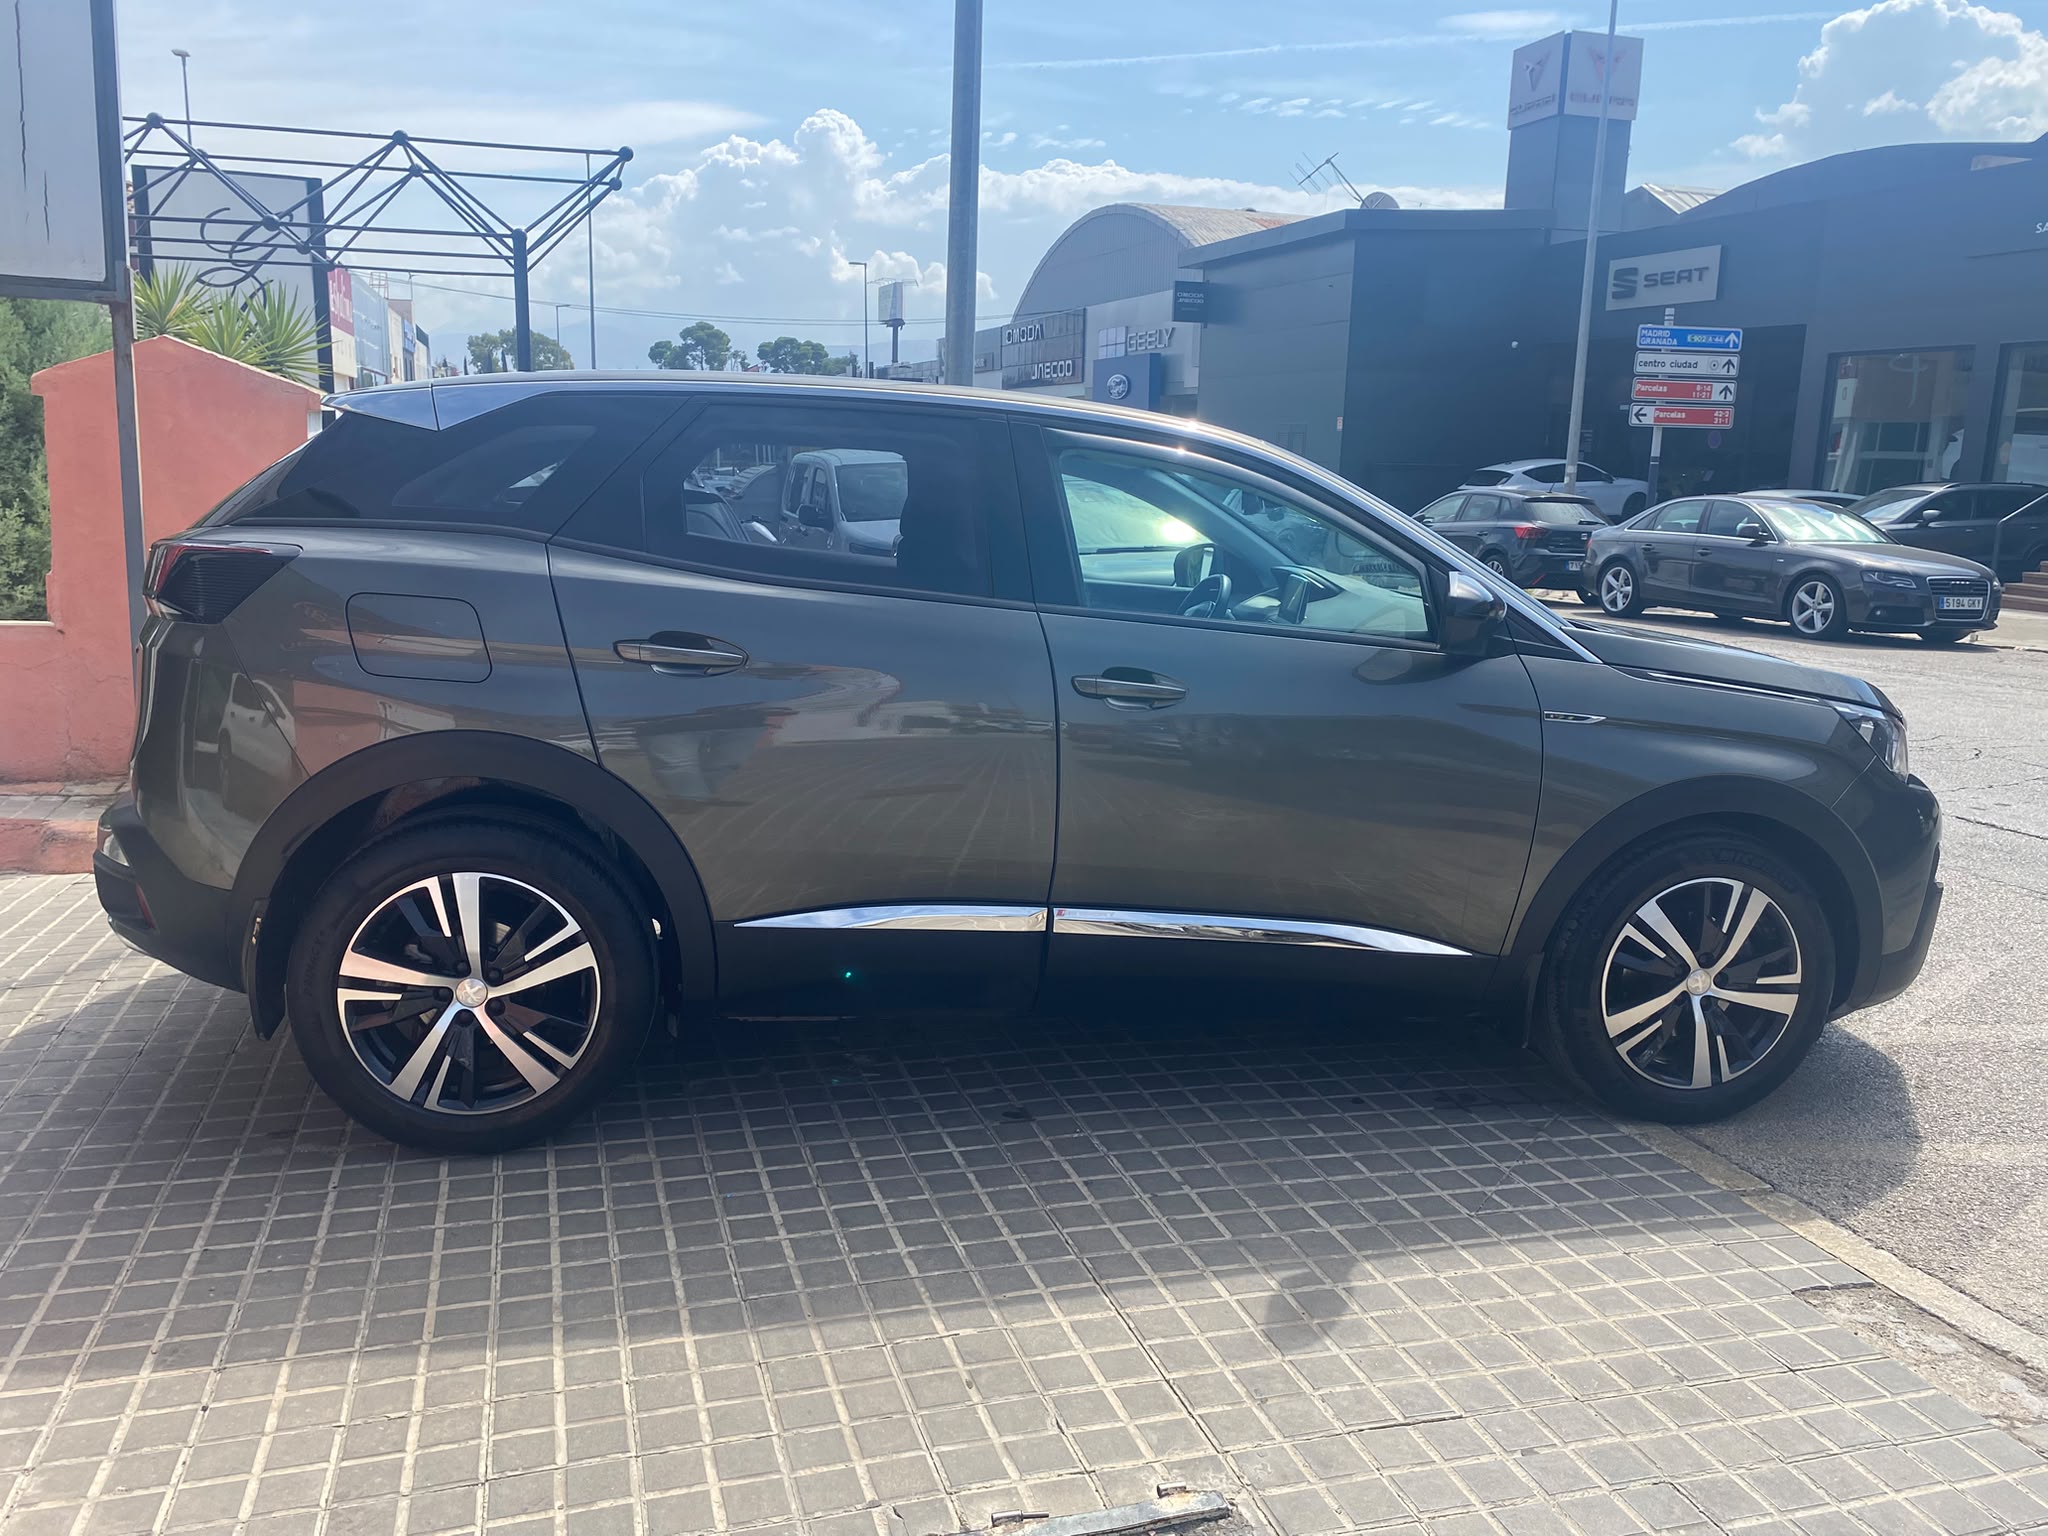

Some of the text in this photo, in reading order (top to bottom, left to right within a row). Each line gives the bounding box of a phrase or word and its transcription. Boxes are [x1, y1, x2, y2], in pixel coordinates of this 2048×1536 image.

[1643, 266, 1710, 288] SEAT
[1005, 323, 1043, 344] OMODA
[1641, 329, 1671, 338] MADRID
[1127, 327, 1176, 352] GEELY
[1640, 337, 1678, 346] GRANADA
[1639, 360, 1699, 369] centro ciudad
[1031, 359, 1073, 380] JAECOO
[1636, 383, 1668, 392] Parcelas
[1654, 410, 1686, 419] Parcelas
[1945, 598, 1966, 608] 5194
